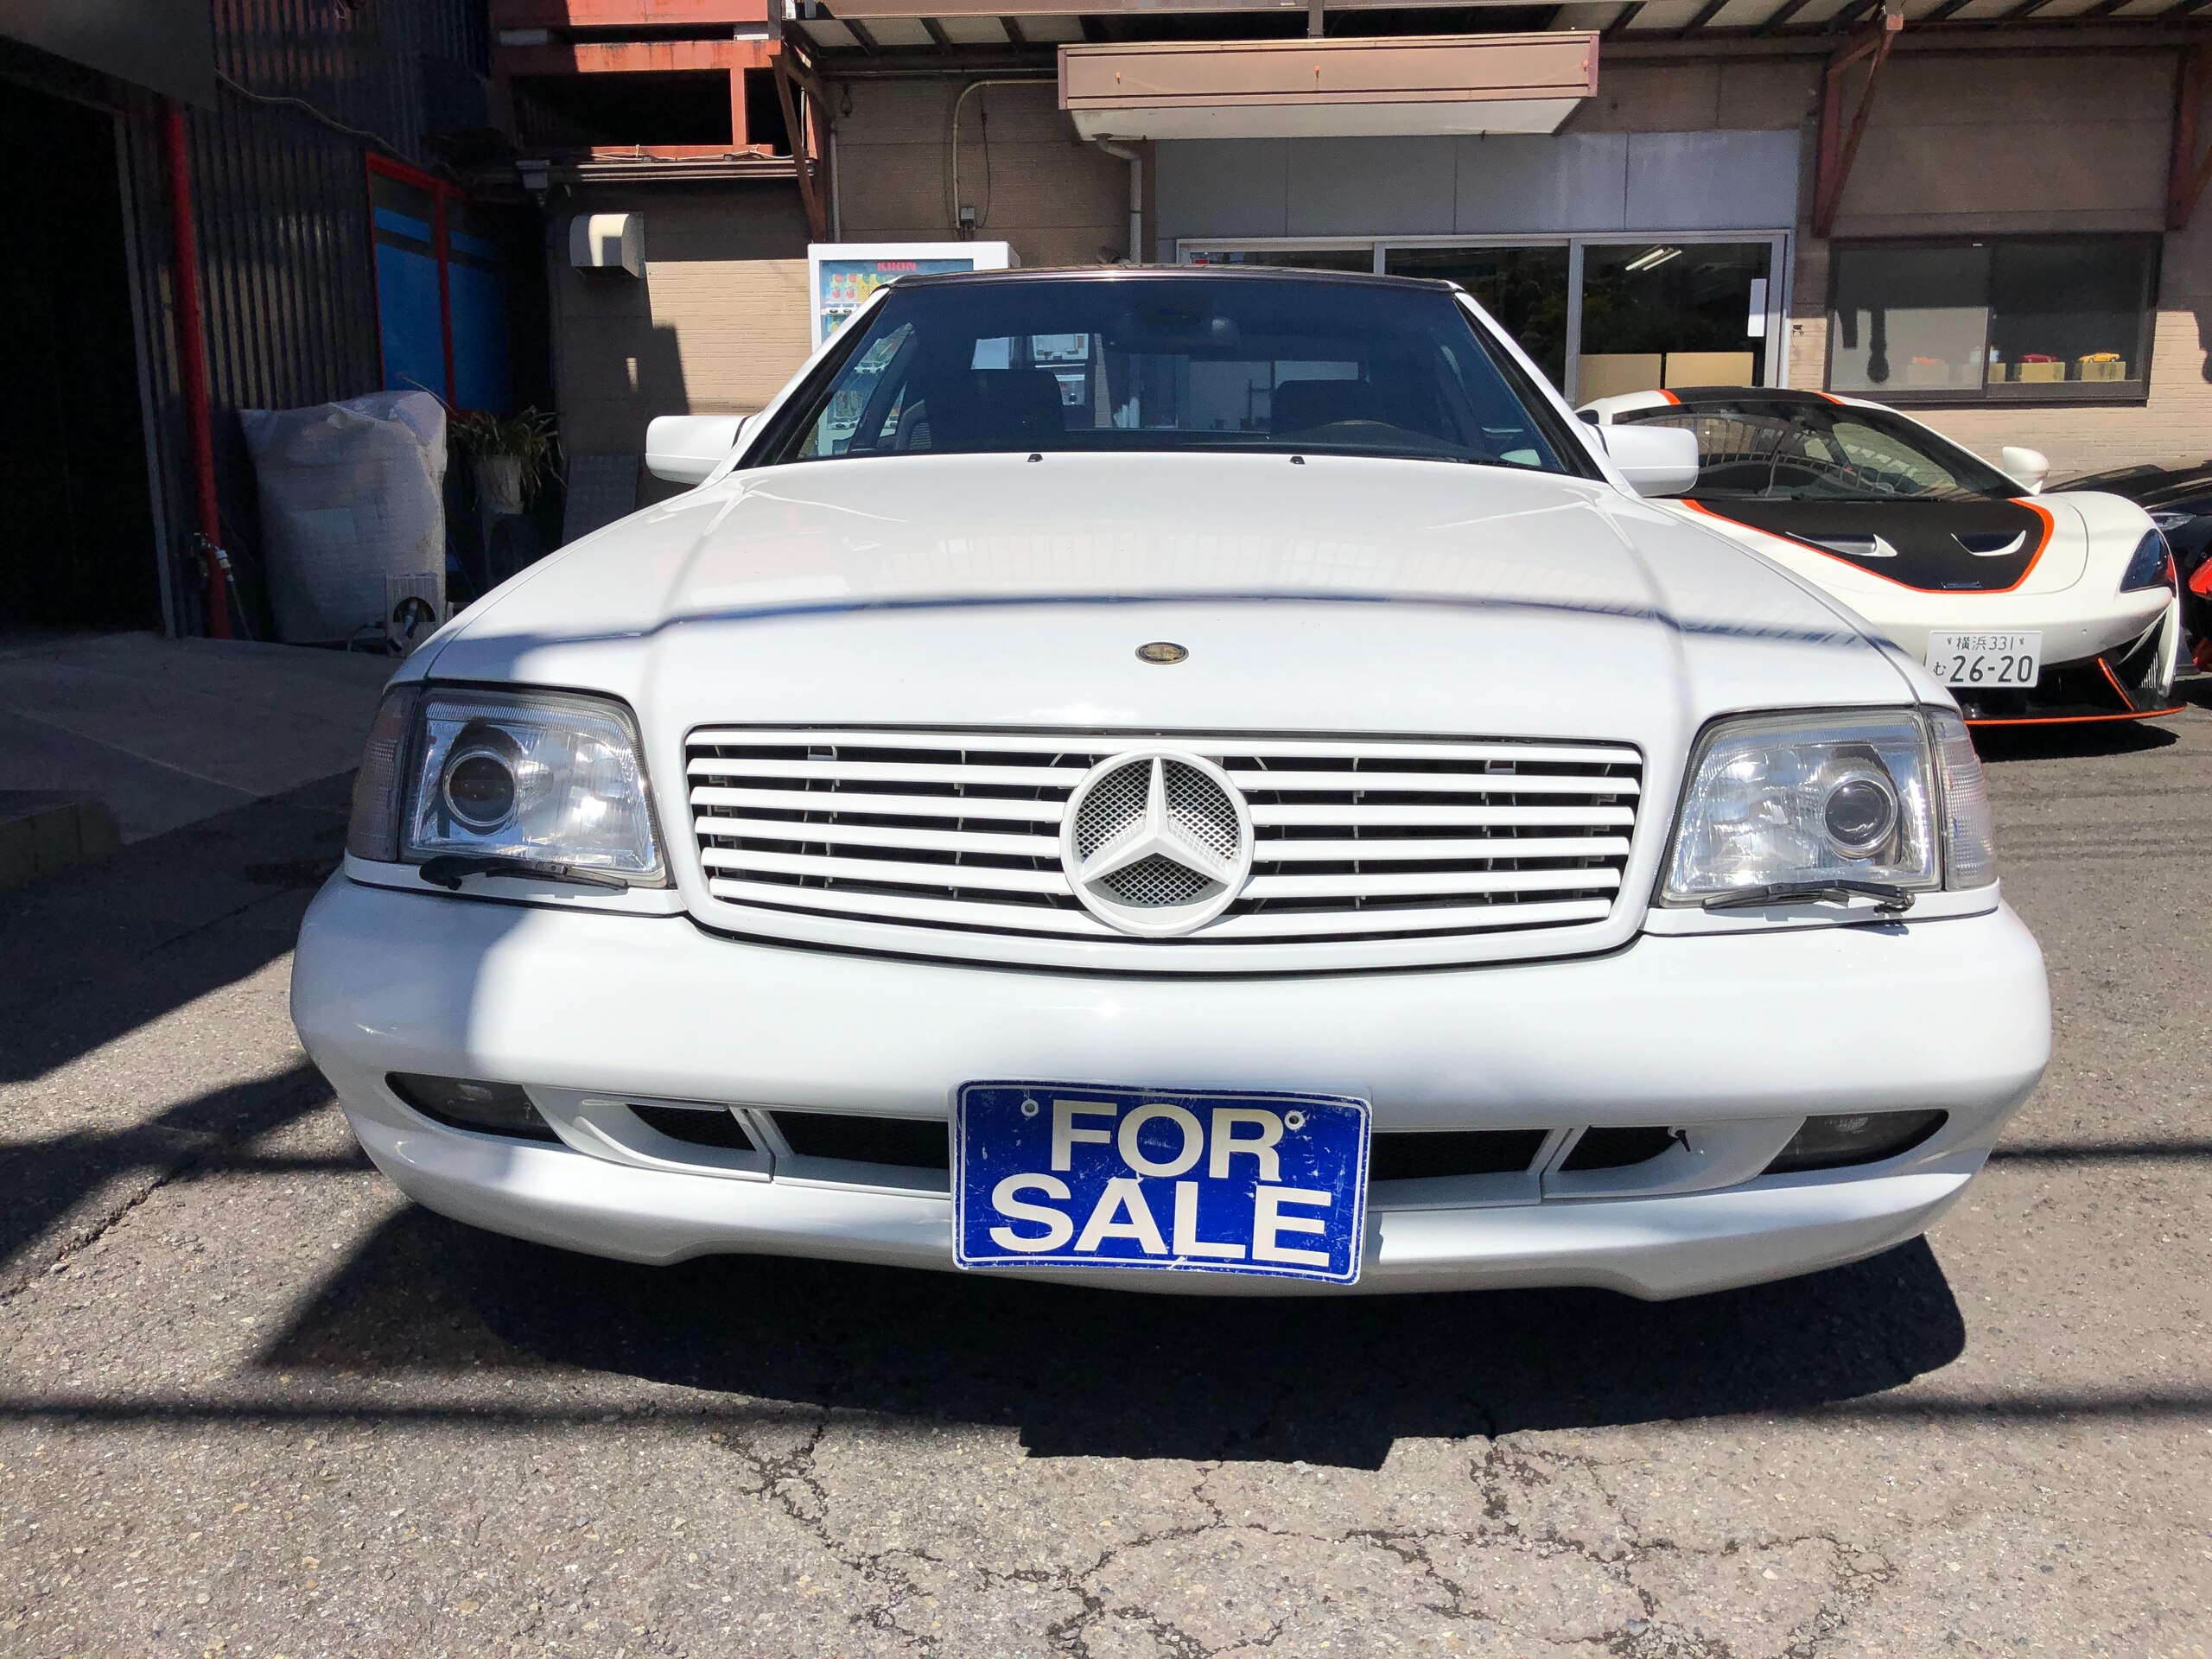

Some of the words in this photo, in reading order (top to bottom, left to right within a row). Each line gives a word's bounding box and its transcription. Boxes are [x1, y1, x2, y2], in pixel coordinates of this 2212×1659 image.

[1933, 661, 1947, 676] む
[1949, 655, 2033, 683] 26-20
[1051, 1098, 1283, 1182] FOR
[989, 1173, 1332, 1268] SALE
